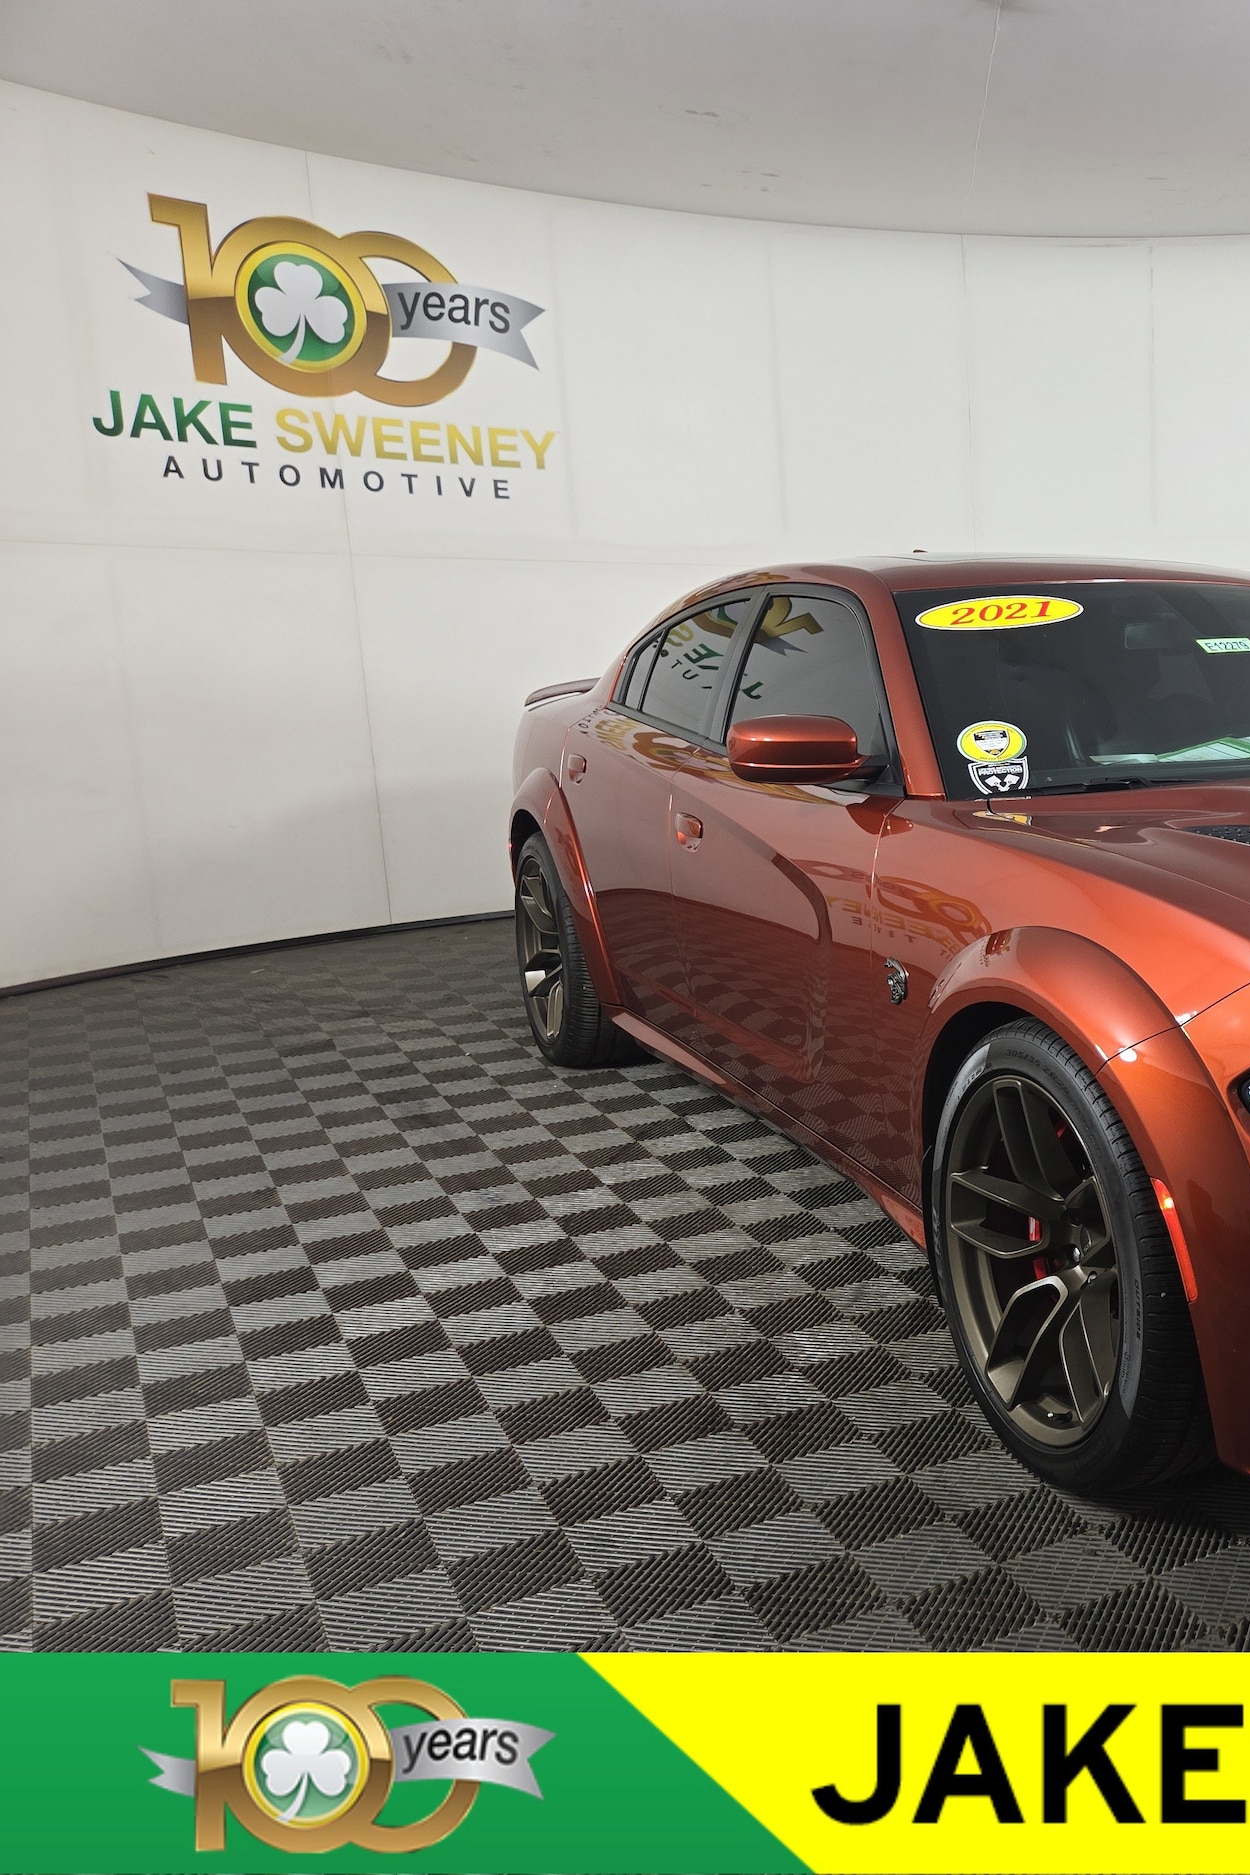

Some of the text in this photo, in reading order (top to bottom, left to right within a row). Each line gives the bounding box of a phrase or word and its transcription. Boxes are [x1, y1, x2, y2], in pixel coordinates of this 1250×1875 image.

[146, 192, 511, 408] 100 years
[92, 389, 556, 470] JAKE SWEENEY
[162, 455, 511, 500] AUTOMOTIVE
[950, 600, 1052, 626] 2021
